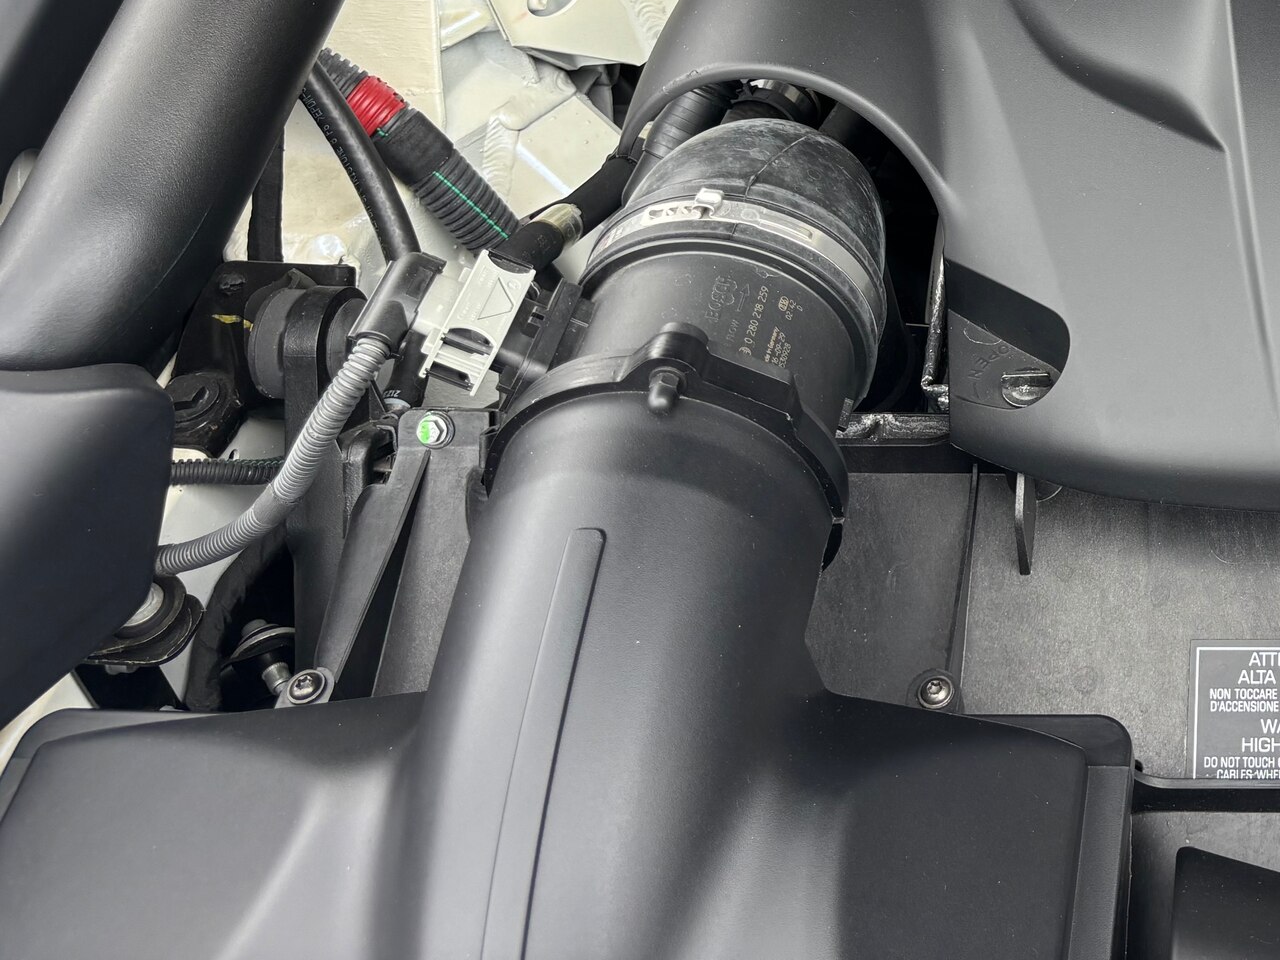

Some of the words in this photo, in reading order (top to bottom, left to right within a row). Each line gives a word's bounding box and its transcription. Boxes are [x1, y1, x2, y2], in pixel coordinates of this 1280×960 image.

[758, 286, 769, 303] 259
[752, 303, 764, 319] 218
[746, 320, 759, 337] 280
[1238, 670, 1276, 684] ALTA
[1210, 688, 1231, 700] NON
[1235, 688, 1278, 700] TOCCARE
[1210, 701, 1279, 712] D'ACCENSIONE
[1204, 756, 1218, 768] DO
[1220, 756, 1240, 768] NOT
[1243, 756, 1275, 768] TOUCH
